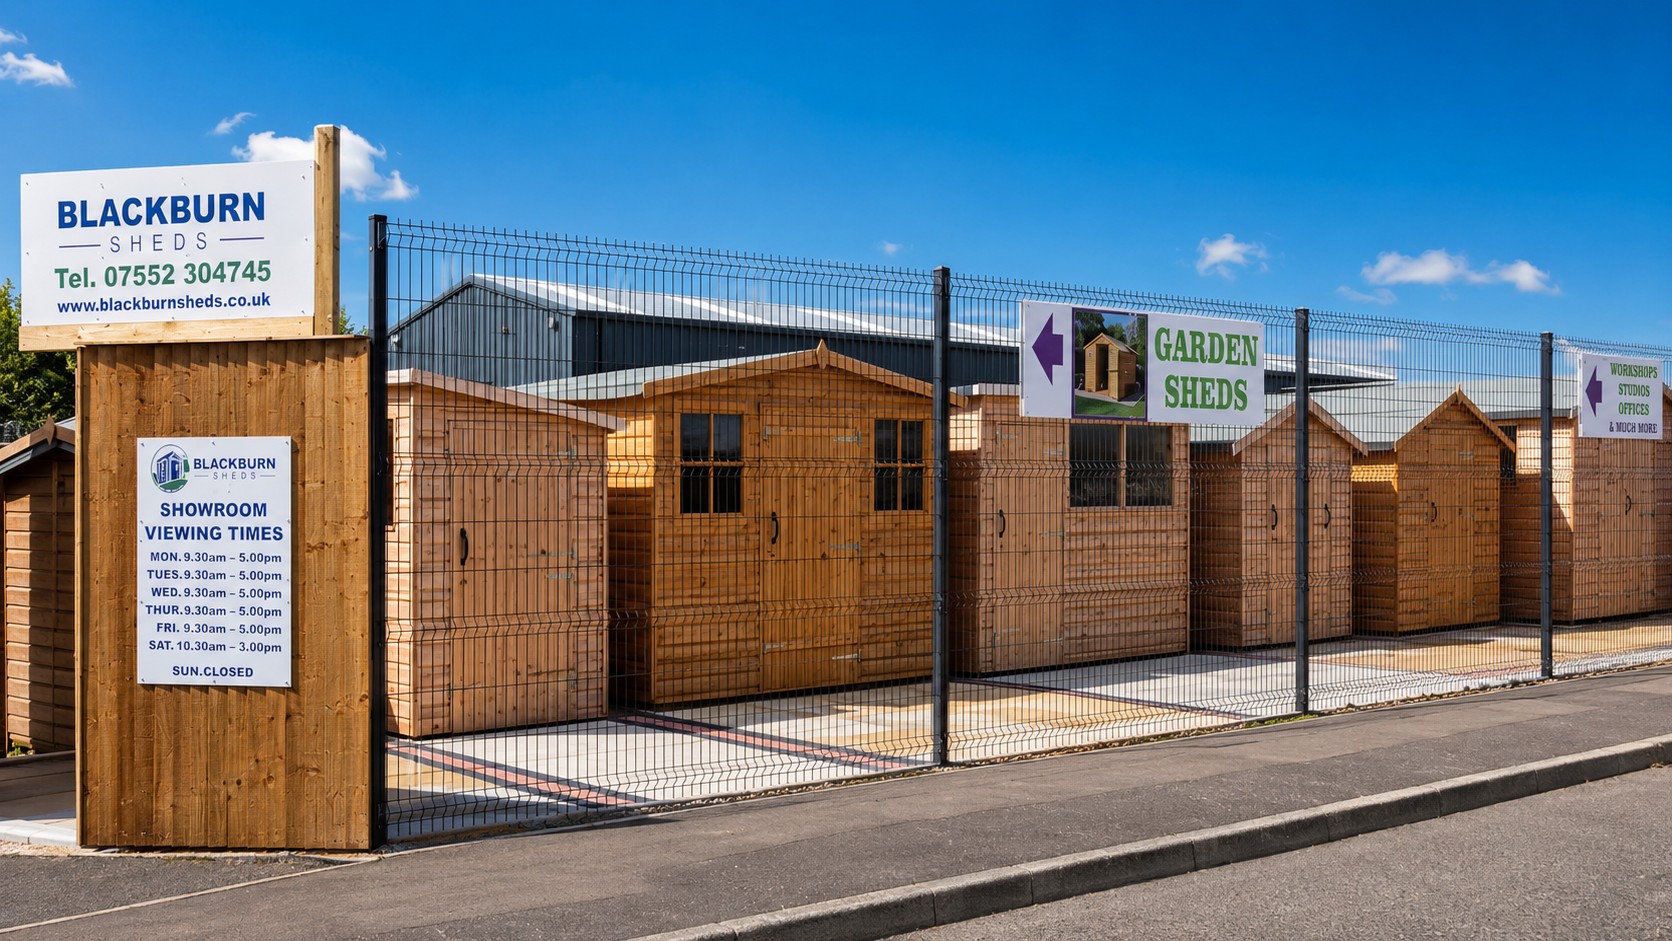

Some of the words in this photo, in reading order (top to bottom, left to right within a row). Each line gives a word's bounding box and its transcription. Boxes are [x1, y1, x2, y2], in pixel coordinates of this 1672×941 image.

[58, 192, 265, 228] BLACKBURN
[110, 232, 207, 252] SHEDS
[54, 268, 96, 288] Tel.
[104, 264, 175, 287] 07552
[184, 260, 271, 284] 304745
[58, 292, 270, 312] www.blackburnsheds.co.uk
[1154, 327, 1258, 366] GARDEN
[1610, 363, 1657, 378] WORKSHOPS
[1164, 374, 1247, 411] SHEDS
[1619, 383, 1650, 397] STUDIOS
[1619, 402, 1649, 415] OFFICES
[1609, 421, 1614, 432] &
[1616, 422, 1636, 432] MUCH
[1638, 423, 1657, 433] MORE
[194, 458, 276, 469] BLACKBURN
[161, 503, 267, 517] SHOWROOM
[145, 526, 222, 540] VIEWING
[228, 527, 283, 541] TIMES
[150, 552, 181, 561] MON.
[184, 552, 226, 562] 9.30am
[239, 553, 281, 564] 5.00pm
[239, 571, 281, 582] 5.00pm
[152, 588, 181, 597] WED.
[184, 588, 226, 597] 9.30am
[239, 589, 281, 600] 5.00pm
[239, 606, 281, 618] 5.00pm
[157, 623, 179, 632] FRI.
[184, 624, 226, 633] 9.30am
[239, 624, 281, 636] 5.00pm
[149, 641, 173, 650] SAT.
[177, 641, 226, 651] 10.30am
[239, 642, 281, 654] 3.00pm
